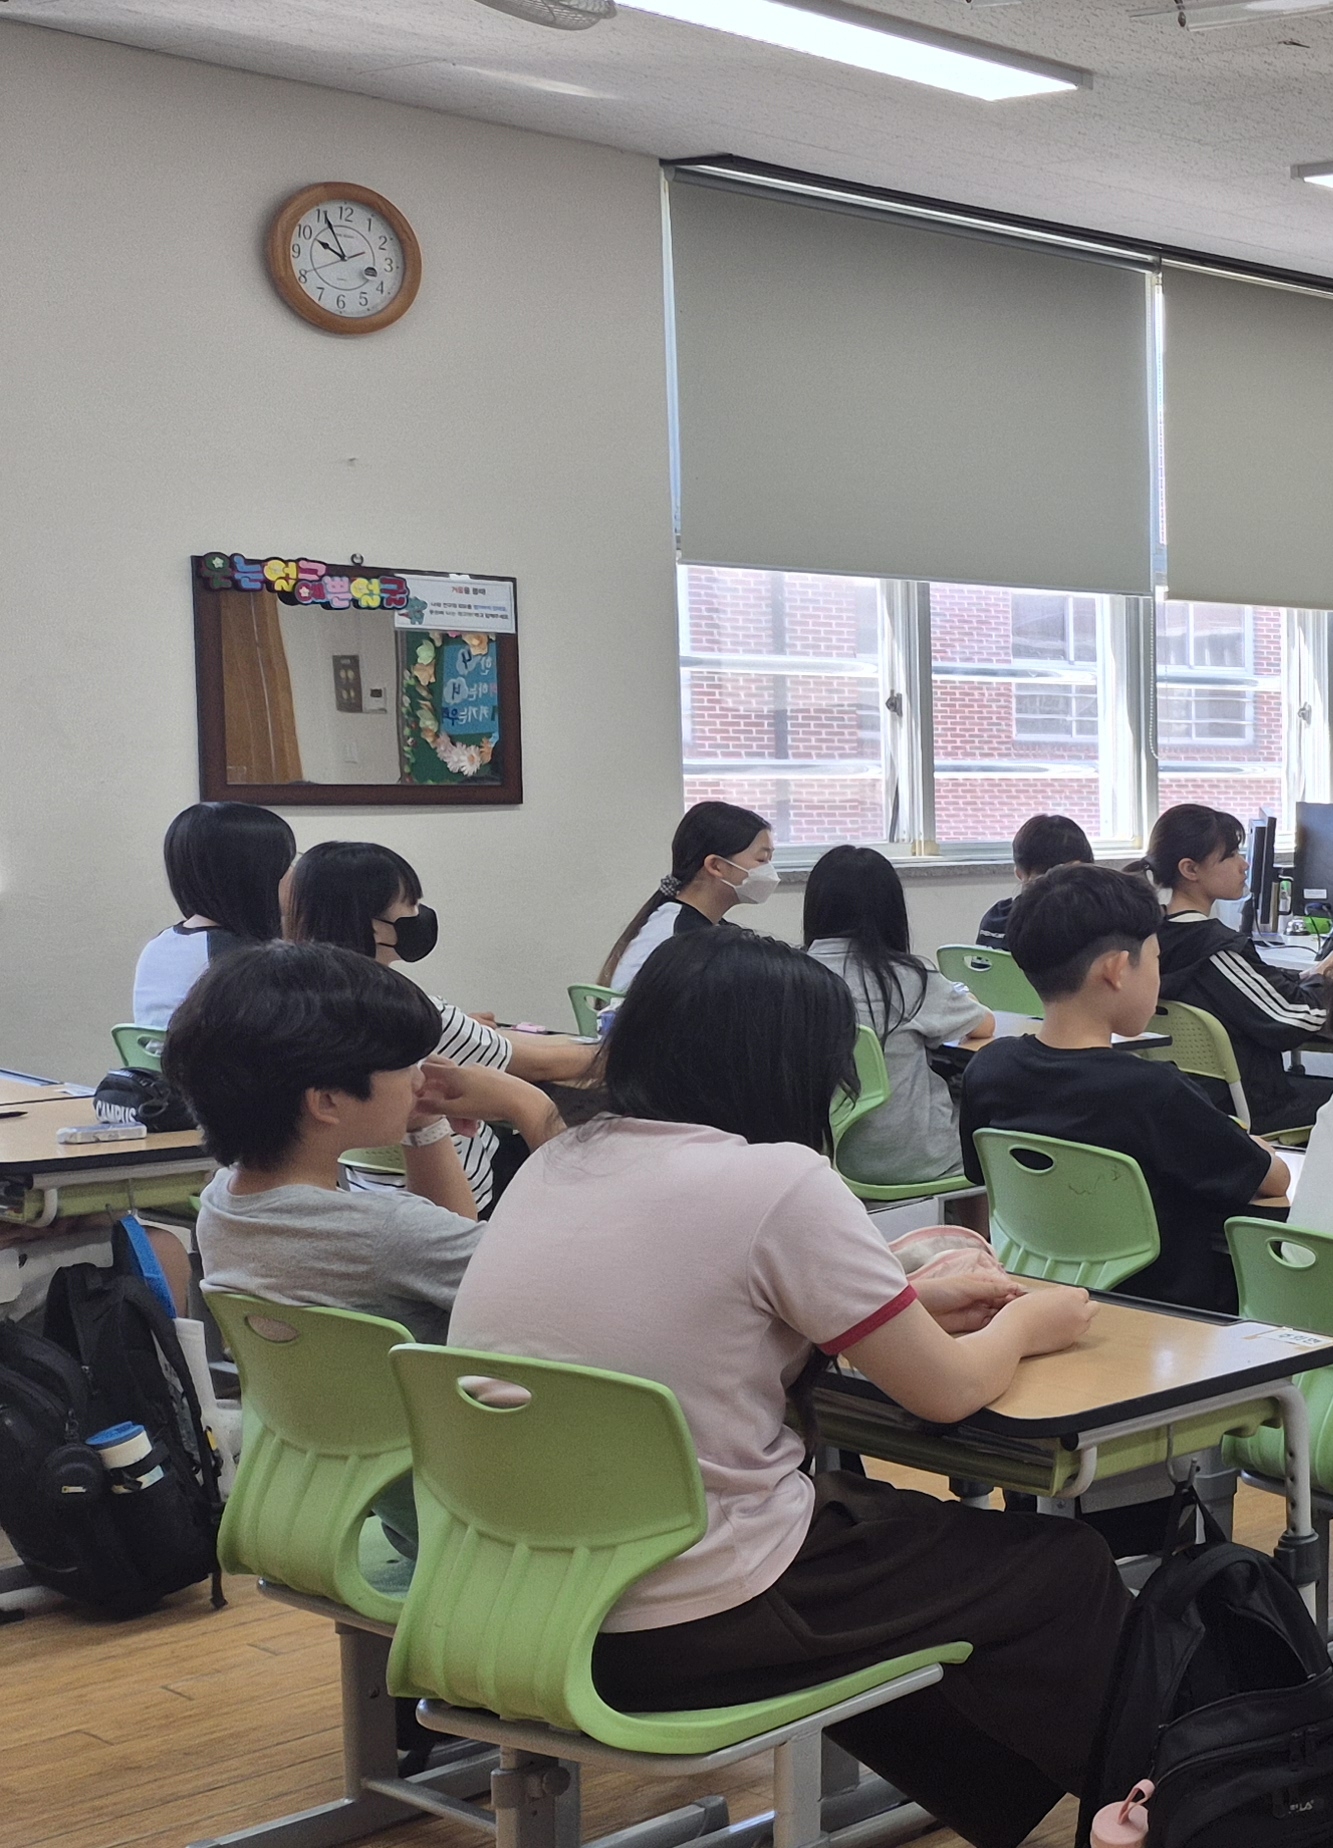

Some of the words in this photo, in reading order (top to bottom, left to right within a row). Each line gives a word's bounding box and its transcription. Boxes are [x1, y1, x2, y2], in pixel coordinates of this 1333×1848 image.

[339, 206, 354, 222] 12
[298, 224, 312, 240] 10
[367, 218, 371, 232] 1
[379, 236, 387, 250] 2
[292, 244, 300, 258] 9
[384, 258, 393, 272] 3
[298, 269, 308, 284] 8
[316, 287, 325, 301] 7
[376, 281, 384, 294] 4
[336, 294, 346, 309] 6
[359, 292, 368, 306] 5
[96, 1100, 138, 1124] CAMPUS
